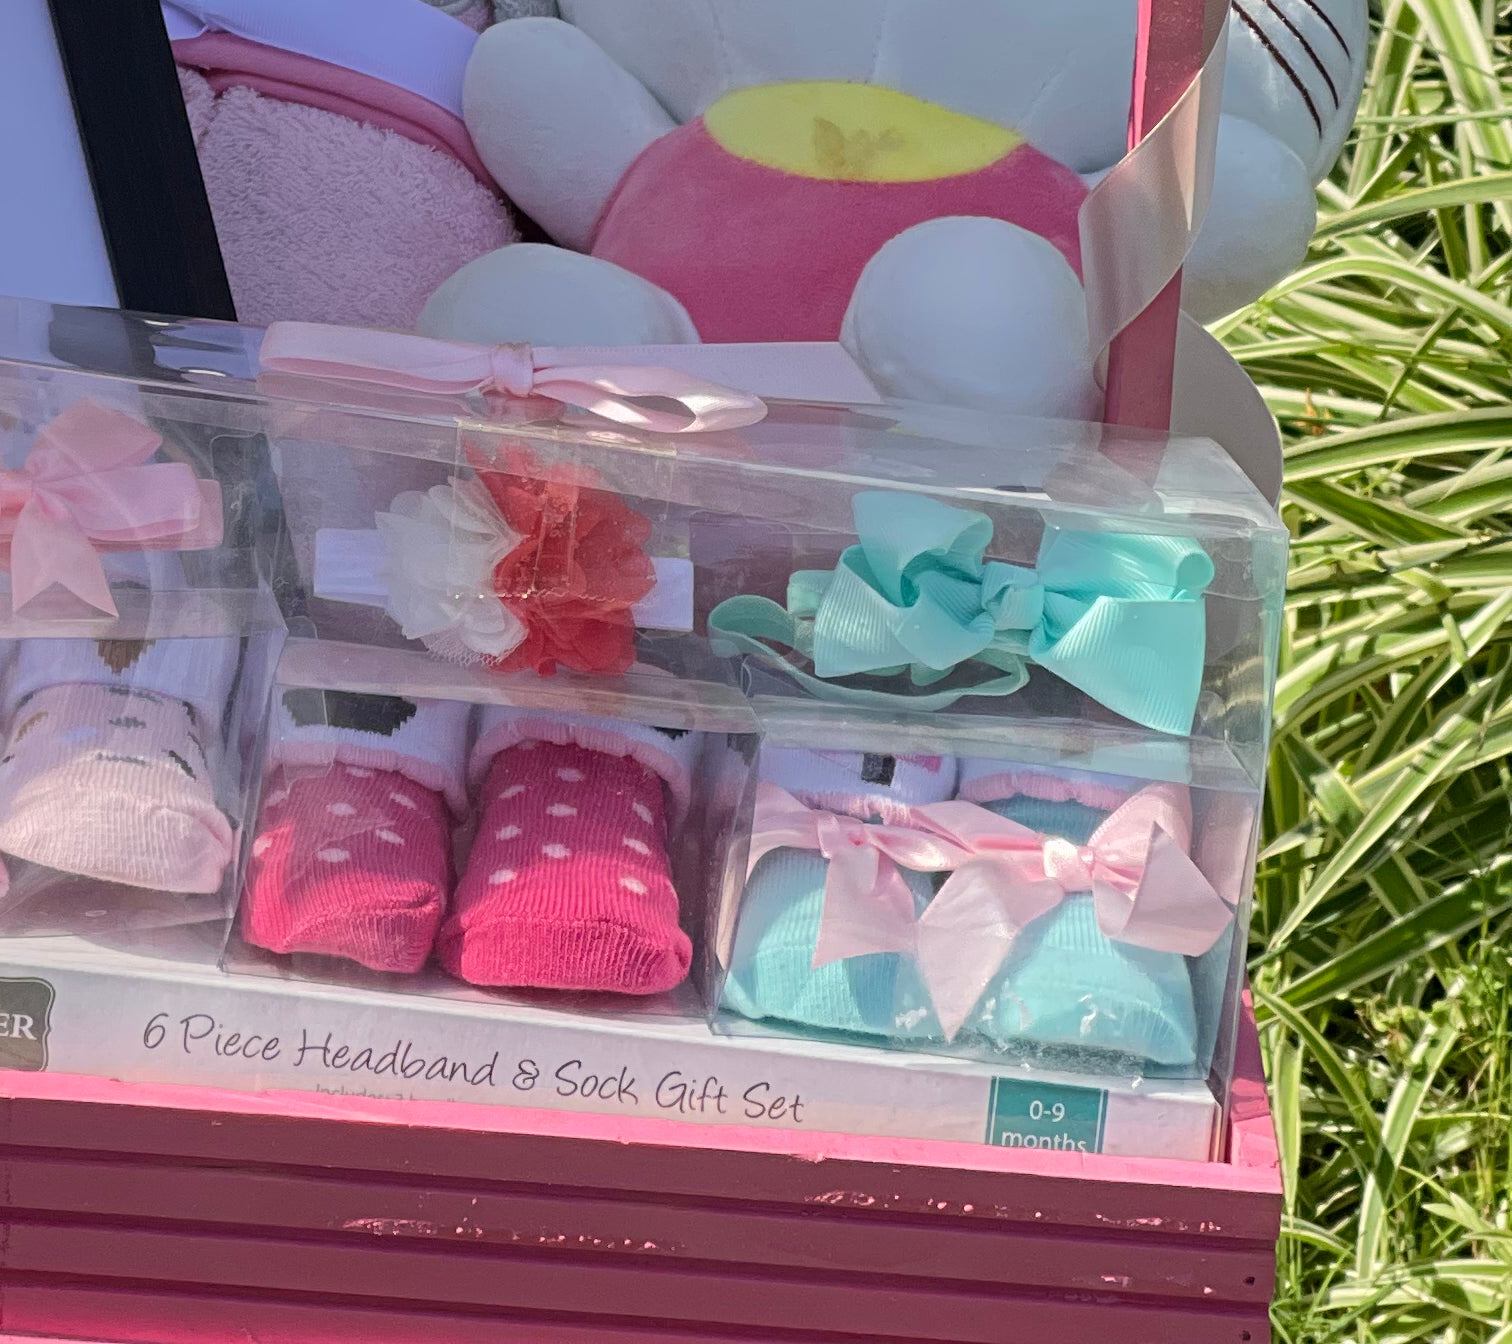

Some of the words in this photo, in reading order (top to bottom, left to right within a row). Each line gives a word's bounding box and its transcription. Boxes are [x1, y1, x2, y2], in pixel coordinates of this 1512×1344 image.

[142, 1012, 169, 1049] 6
[180, 1014, 281, 1061] Piece
[294, 1028, 499, 1087] Headband
[512, 1059, 540, 1091] &
[554, 1058, 639, 1104] Sock
[654, 1071, 729, 1114] Gift
[741, 1082, 804, 1123] Set
[1029, 1099, 1066, 1123] 0-9
[1001, 1131, 1088, 1152] months
